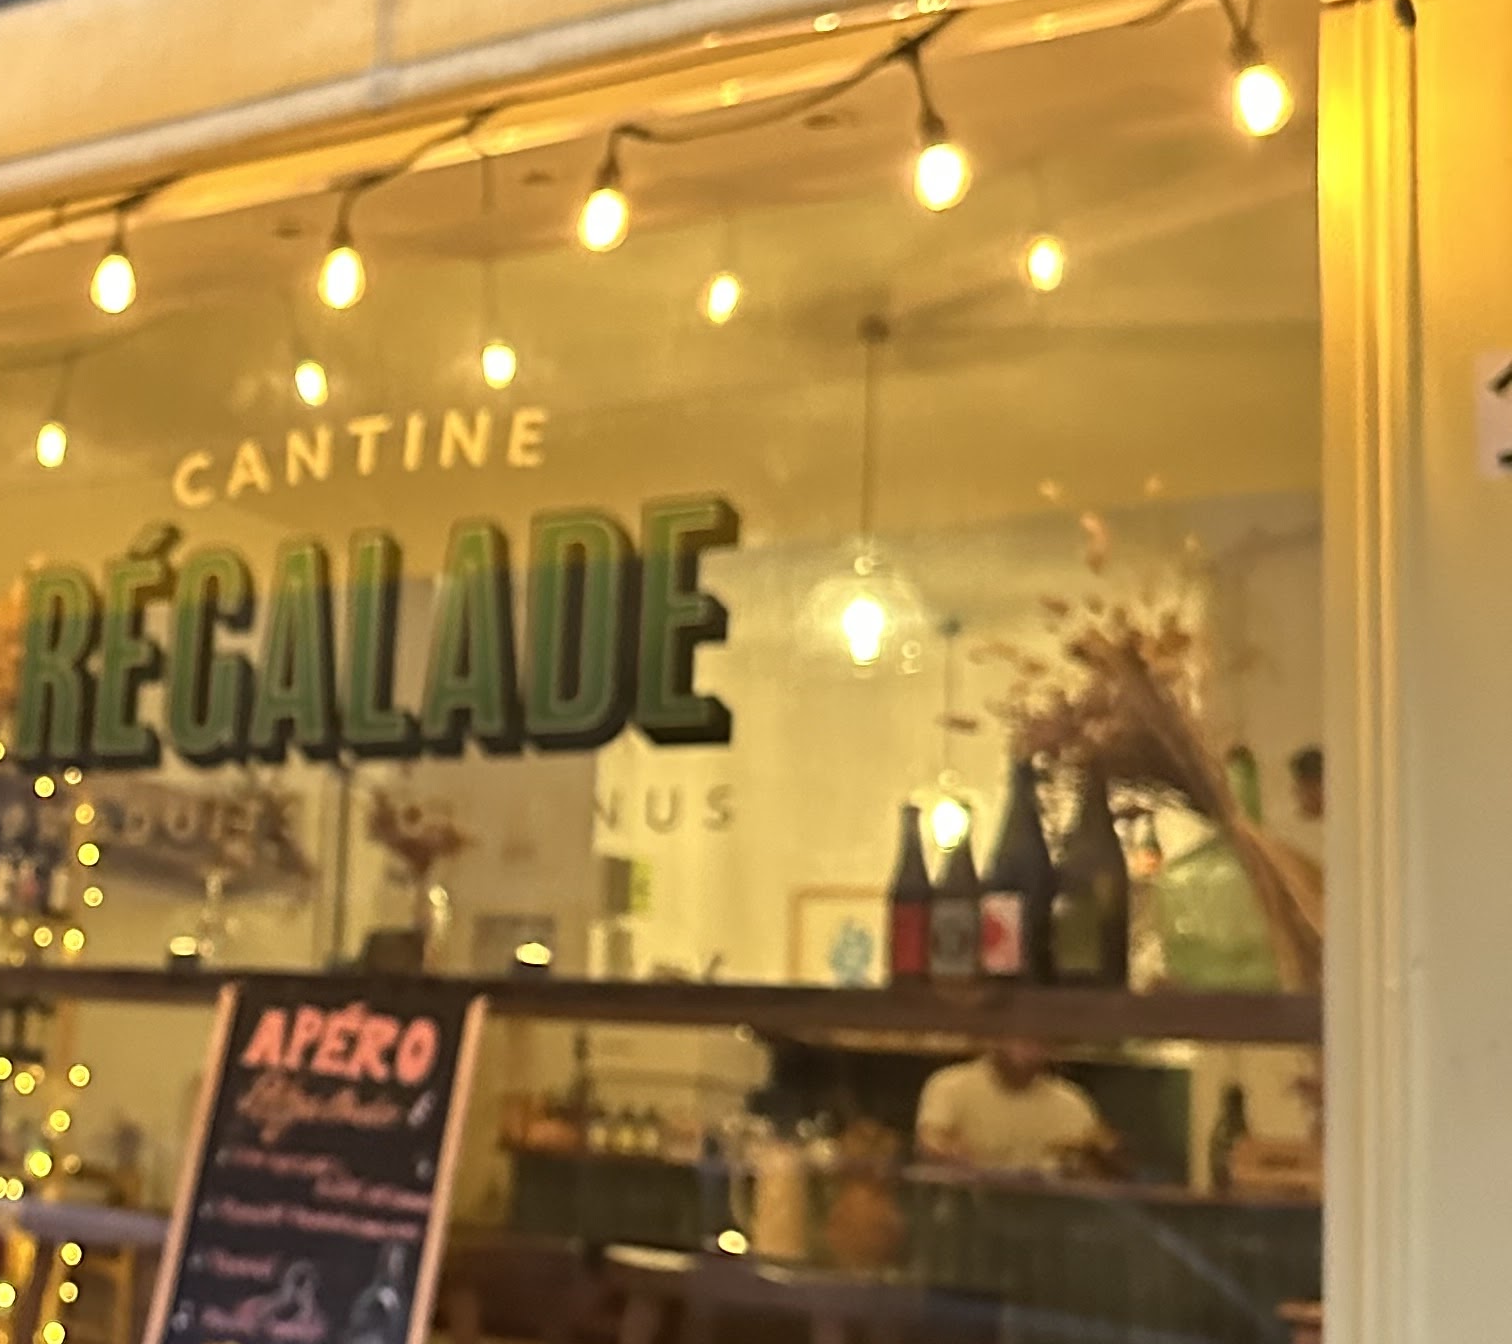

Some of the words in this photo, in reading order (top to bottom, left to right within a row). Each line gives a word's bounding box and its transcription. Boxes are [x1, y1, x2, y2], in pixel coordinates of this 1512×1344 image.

[171, 405, 552, 510] CANTINE
[14, 490, 741, 772] RÉGALADE
[239, 1000, 440, 1087] APÉRO
